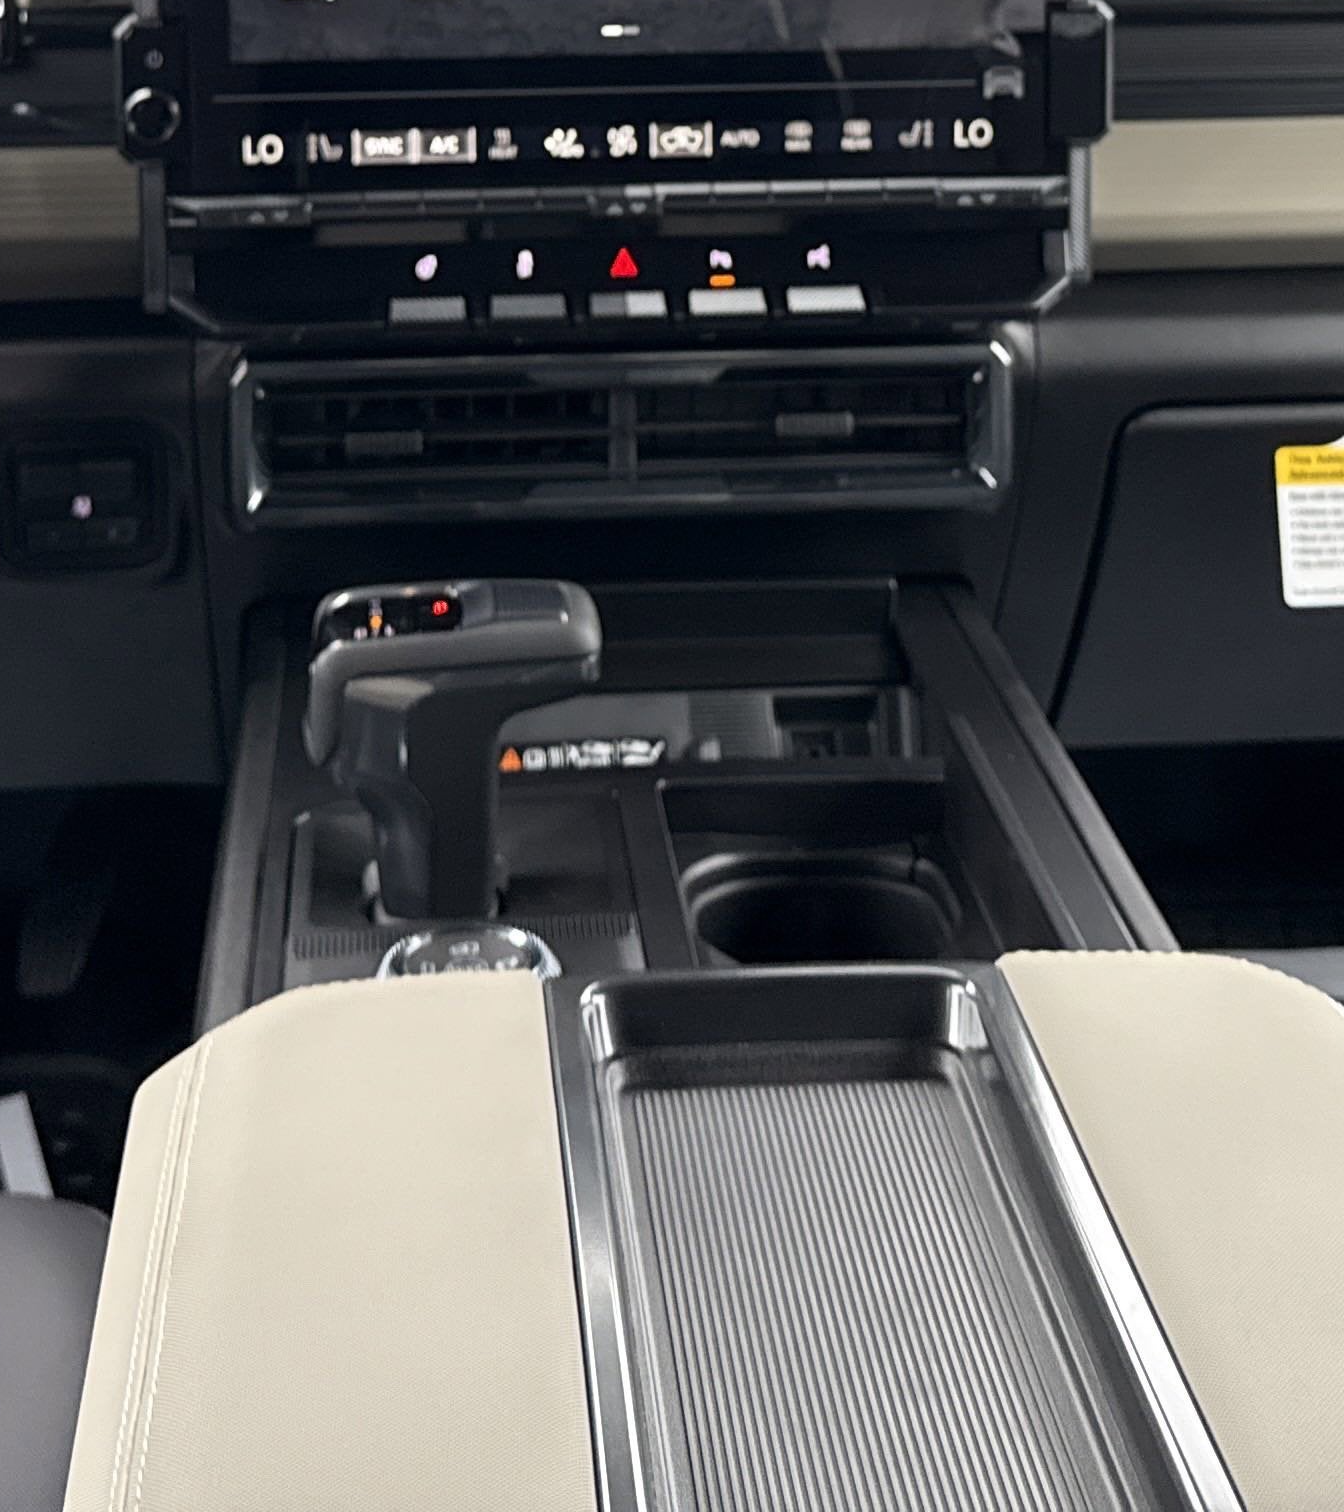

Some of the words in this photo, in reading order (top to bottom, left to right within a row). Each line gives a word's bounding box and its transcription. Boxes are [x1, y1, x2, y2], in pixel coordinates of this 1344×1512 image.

[363, 135, 404, 156] SYNC
[429, 135, 459, 155] A/C
[953, 117, 994, 149] LO
[241, 133, 284, 166] LO
